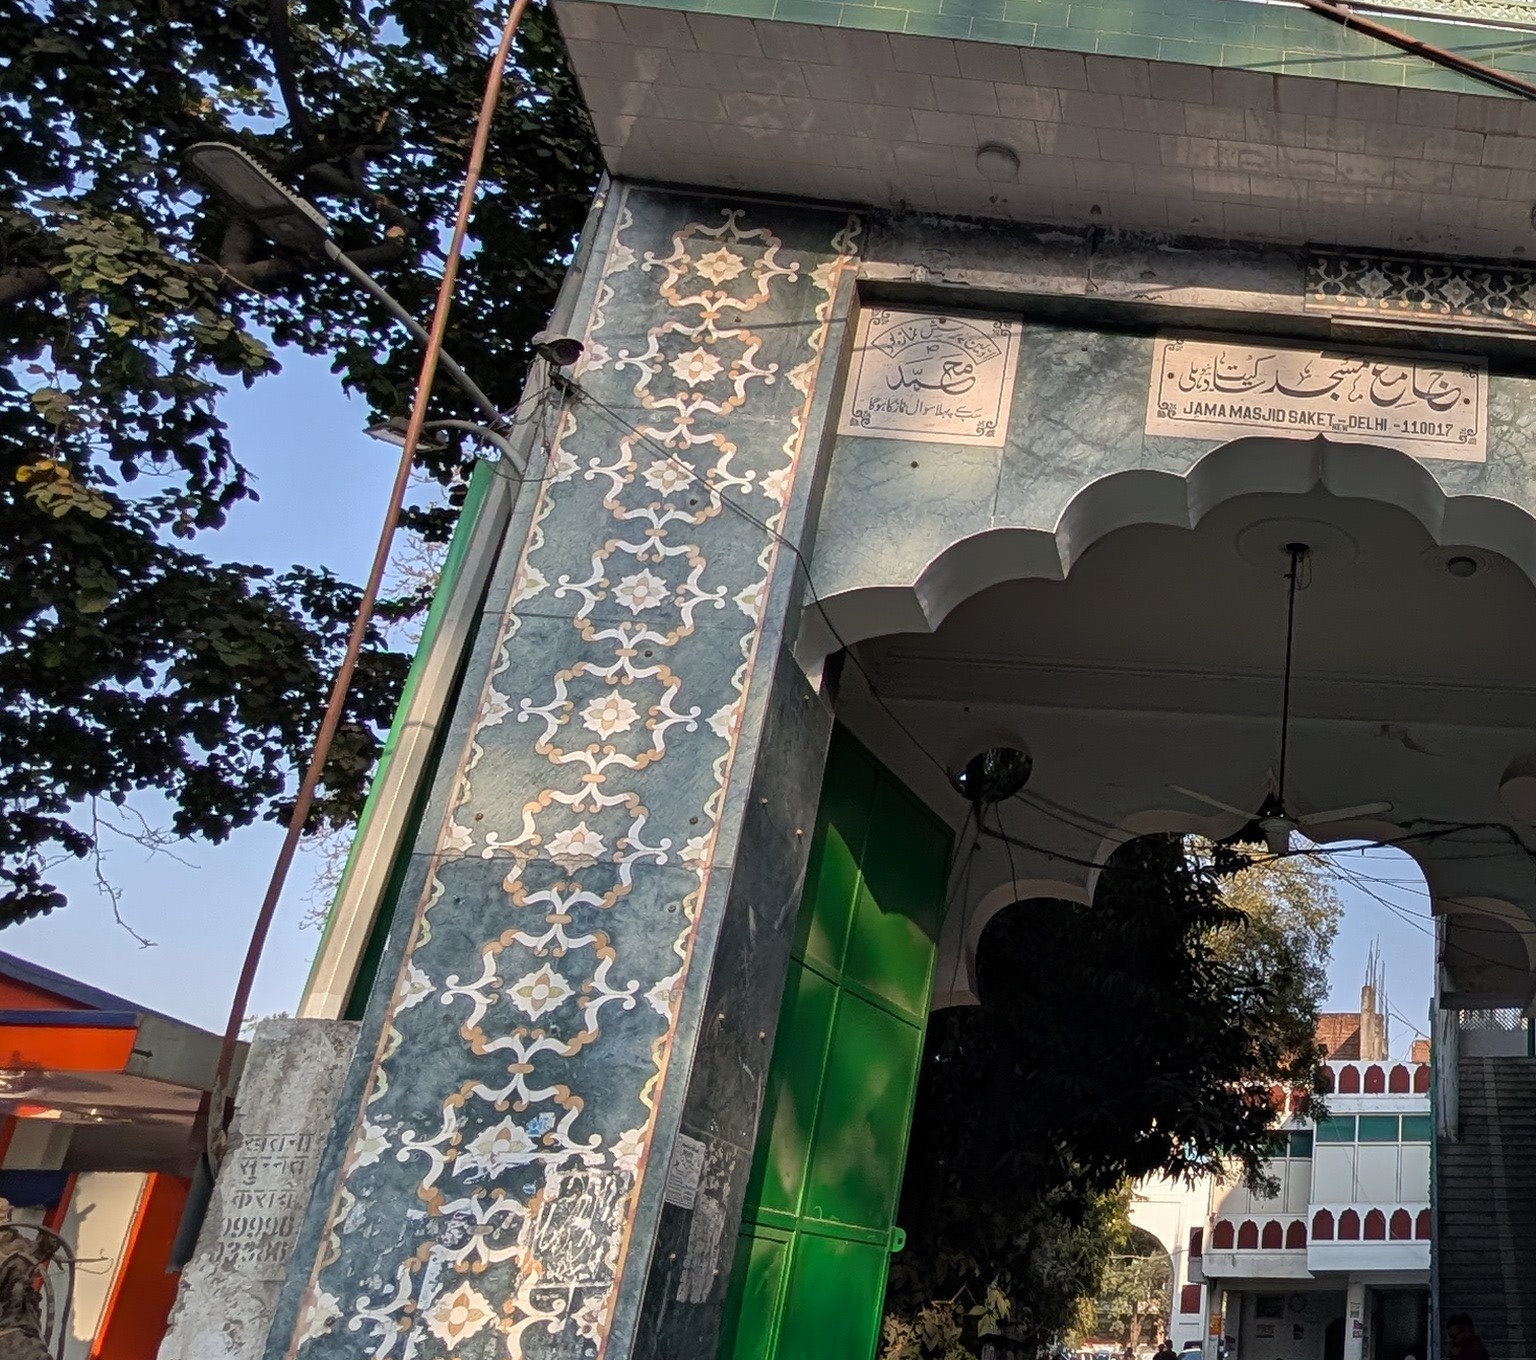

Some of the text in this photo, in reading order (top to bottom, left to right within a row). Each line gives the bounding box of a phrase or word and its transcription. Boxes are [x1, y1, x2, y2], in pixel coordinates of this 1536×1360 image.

[1183, 402, 1227, 418] JAMA
[1228, 405, 1285, 423] MASJID
[1288, 411, 1335, 427] SAKET
[1348, 415, 1388, 431] DELHI
